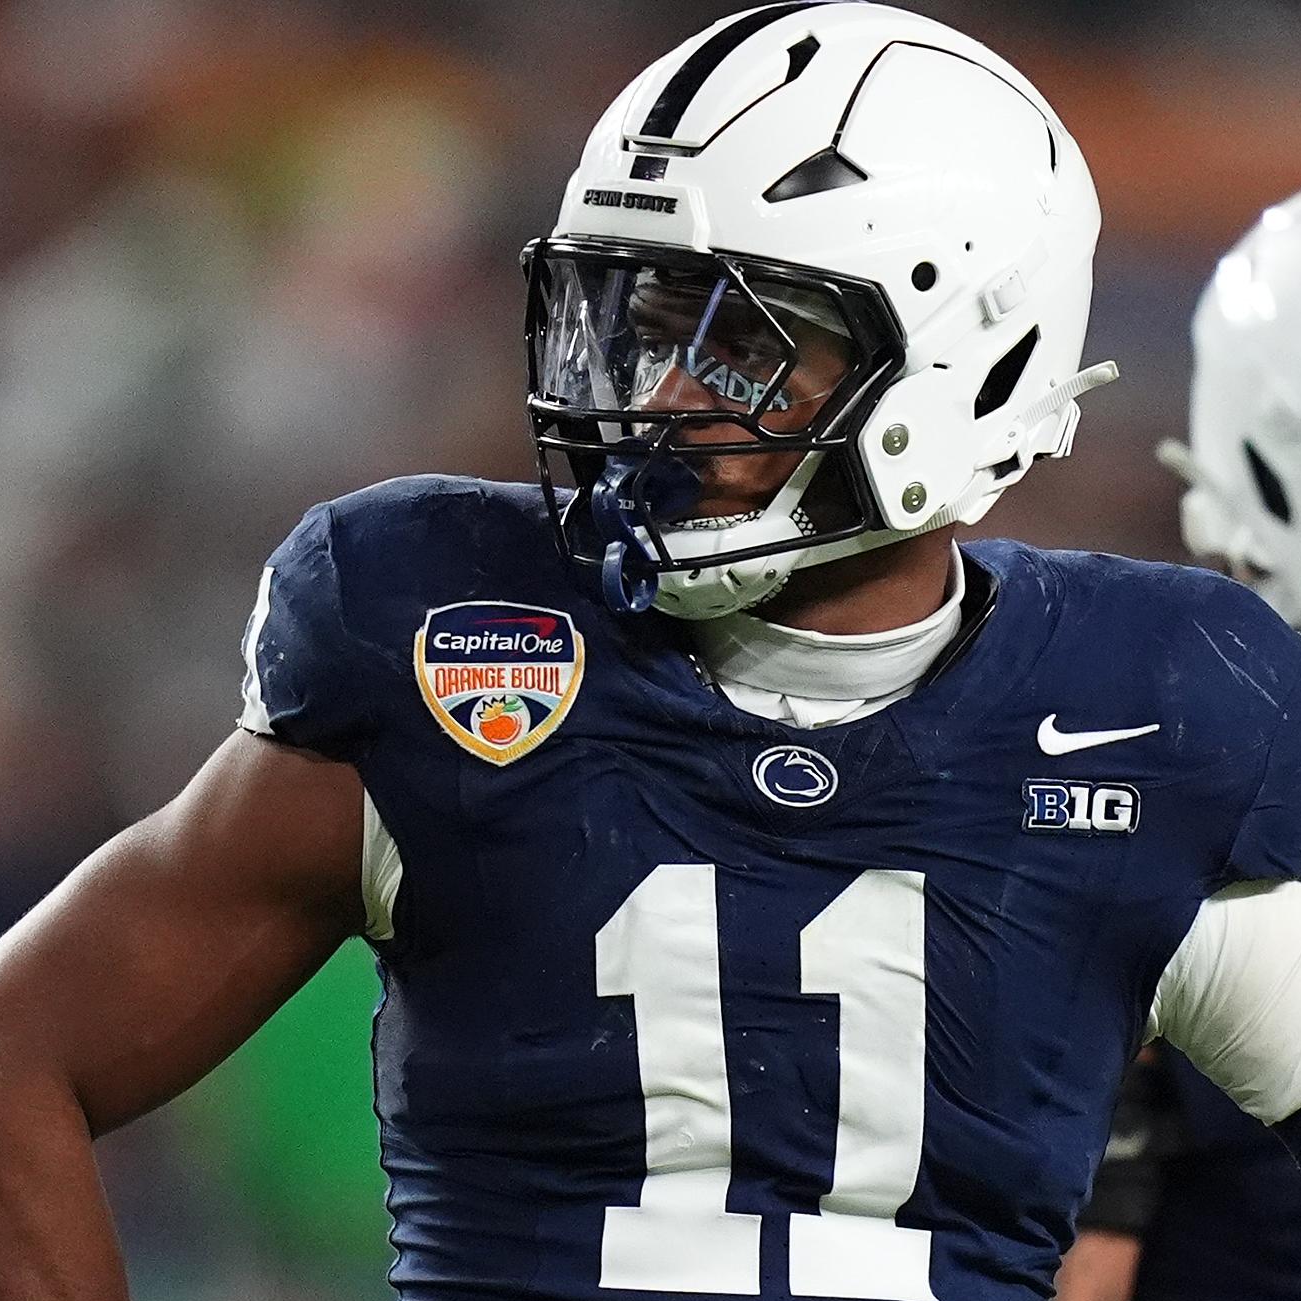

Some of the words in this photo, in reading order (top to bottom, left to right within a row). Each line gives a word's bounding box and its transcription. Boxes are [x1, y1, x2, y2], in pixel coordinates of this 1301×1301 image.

[583, 189, 623, 207] PENN
[622, 192, 678, 214] STATE
[434, 667, 506, 698] ORANGE
[511, 667, 564, 696] BOWL
